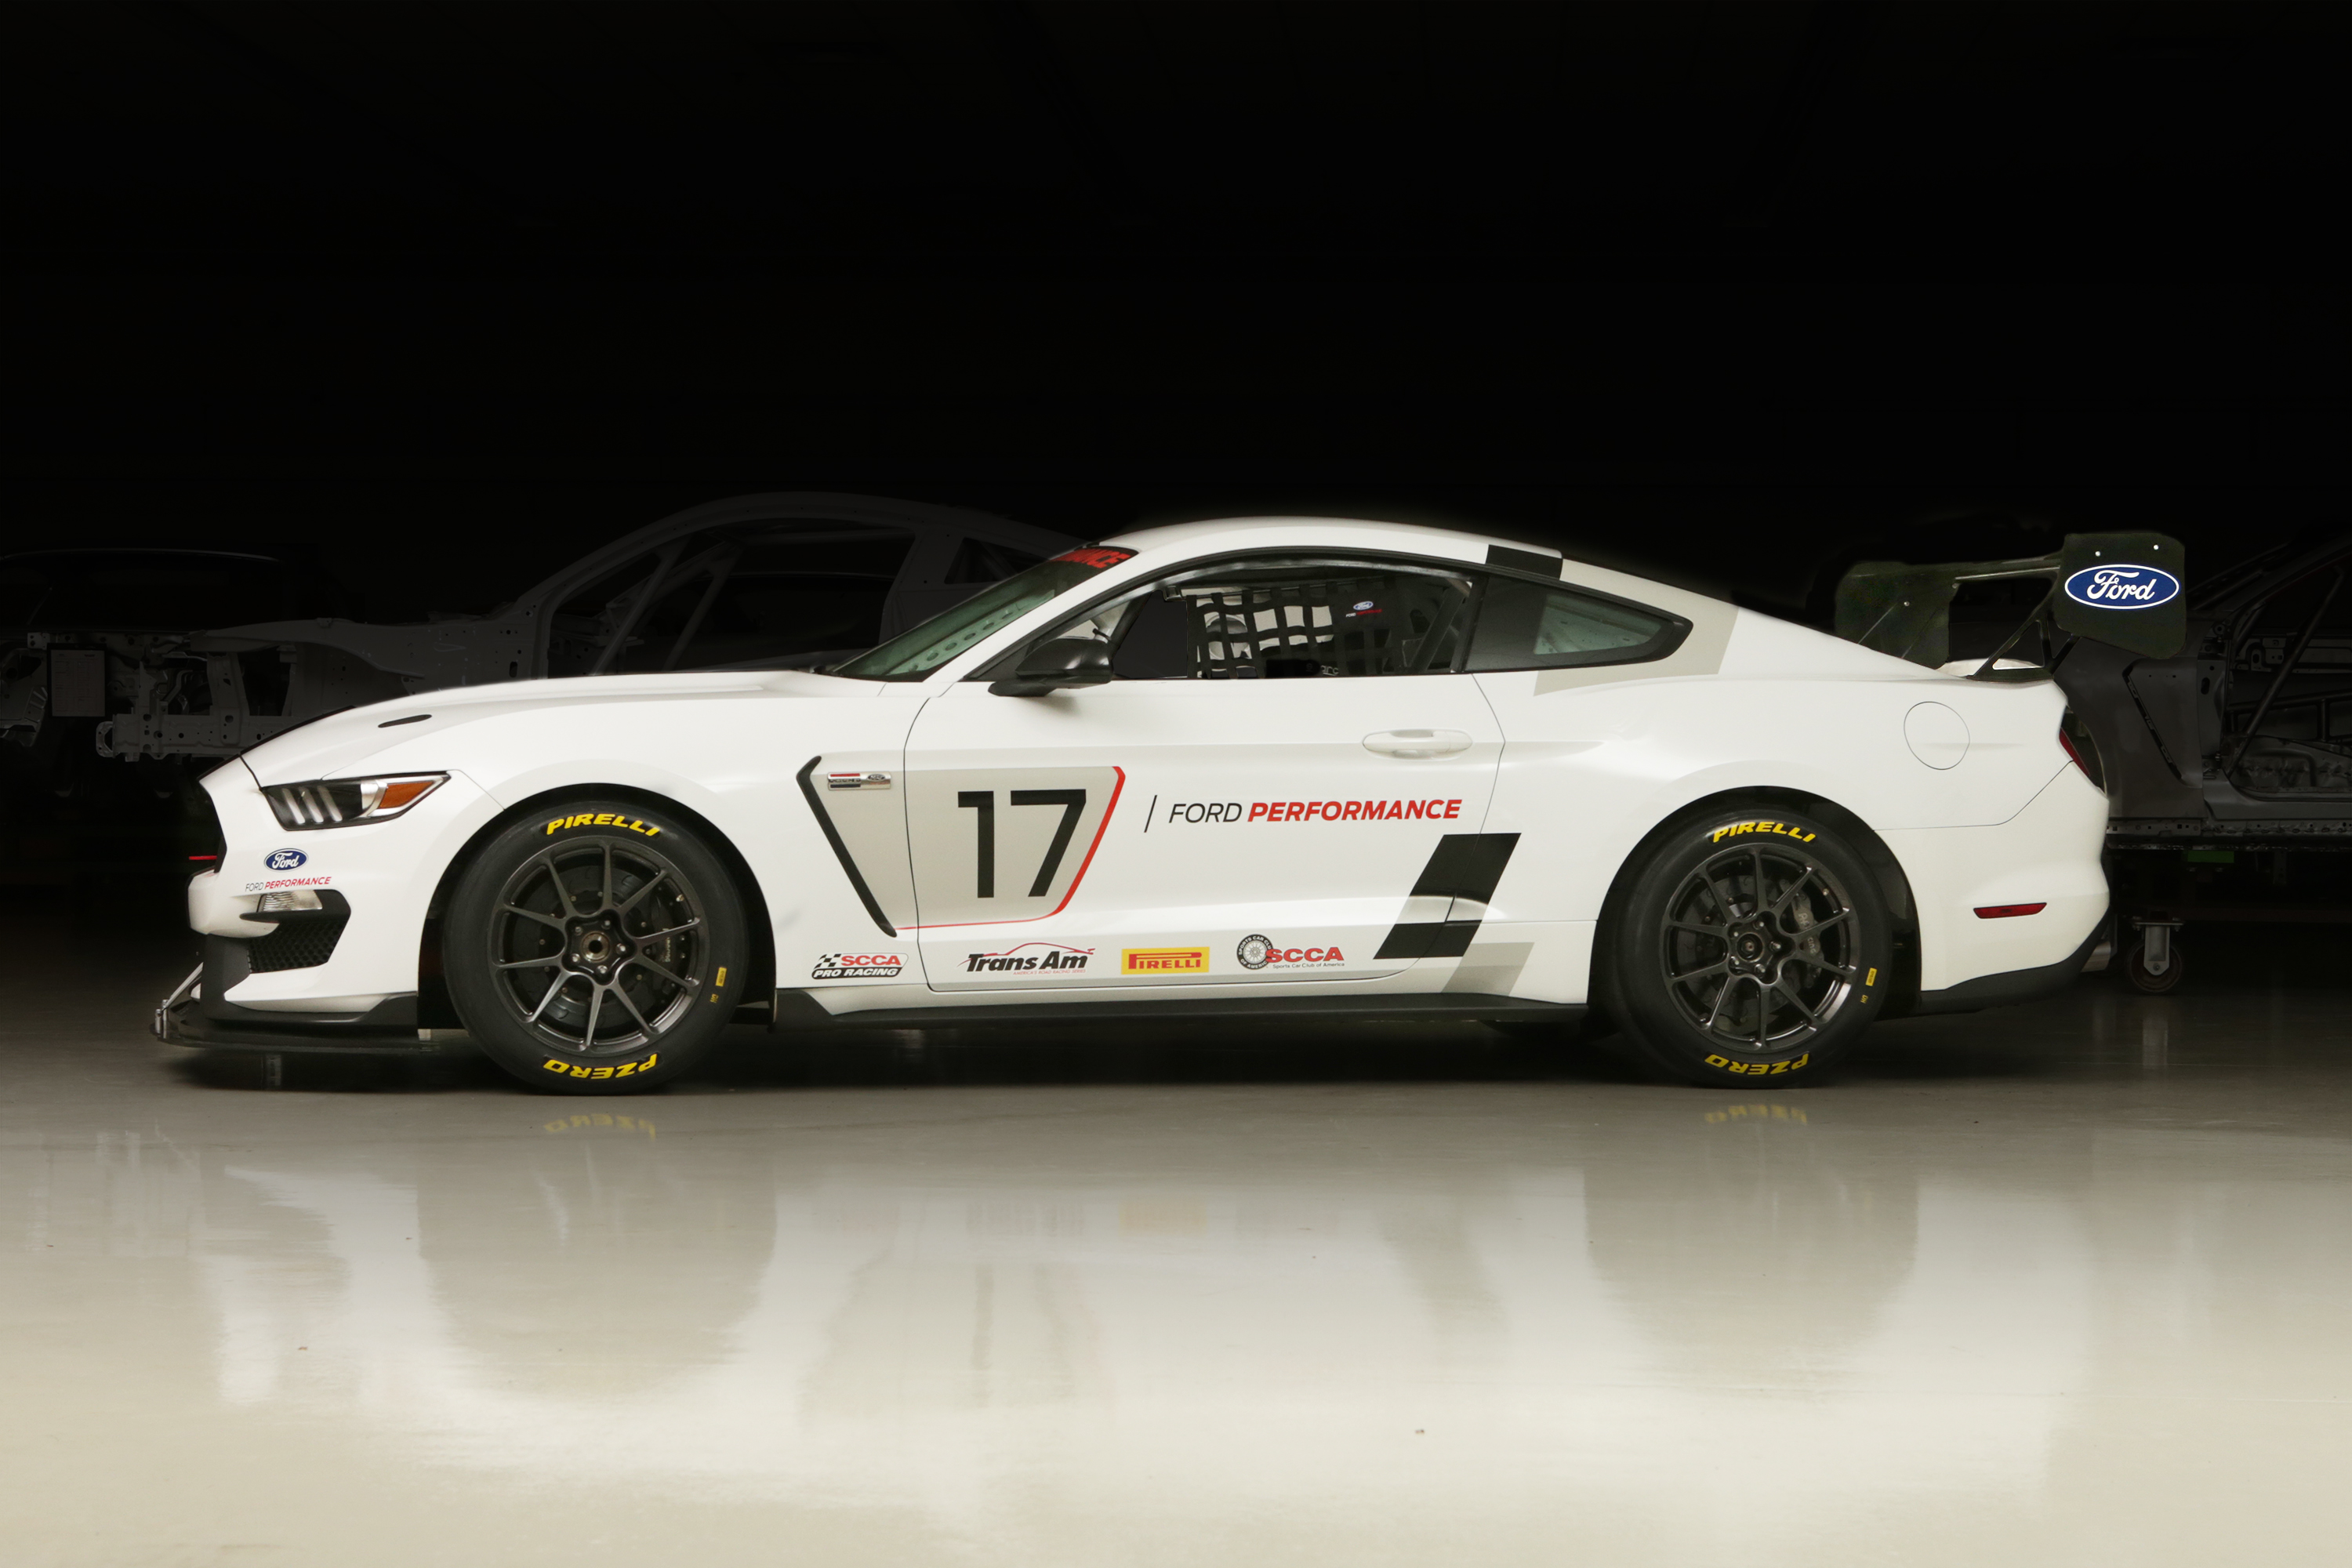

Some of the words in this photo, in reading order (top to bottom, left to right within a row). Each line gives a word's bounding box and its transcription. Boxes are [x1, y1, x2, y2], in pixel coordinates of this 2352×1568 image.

[2087, 569, 2157, 601] Ford
[1168, 802, 1243, 824] FORD
[1247, 799, 1463, 822] PERFORMANCE
[546, 813, 660, 837] PIRELLI
[1712, 821, 1817, 843] PIRELLI
[957, 789, 1087, 898] 17
[271, 852, 300, 869] Ford
[245, 882, 264, 892] FORD
[264, 876, 332, 890] PERFORMANCE
[840, 955, 902, 967] SCCA
[966, 953, 1040, 972] Trans
[1038, 950, 1088, 971] Am
[1128, 951, 1203, 970] PIRELLI
[1247, 960, 1267, 969] AMERIC
[1265, 946, 1345, 964] SCCA
[813, 968, 842, 978] PRO
[843, 967, 898, 976] RACING
[543, 1053, 659, 1080] PZERO
[1704, 1053, 1809, 1076] PZERO
